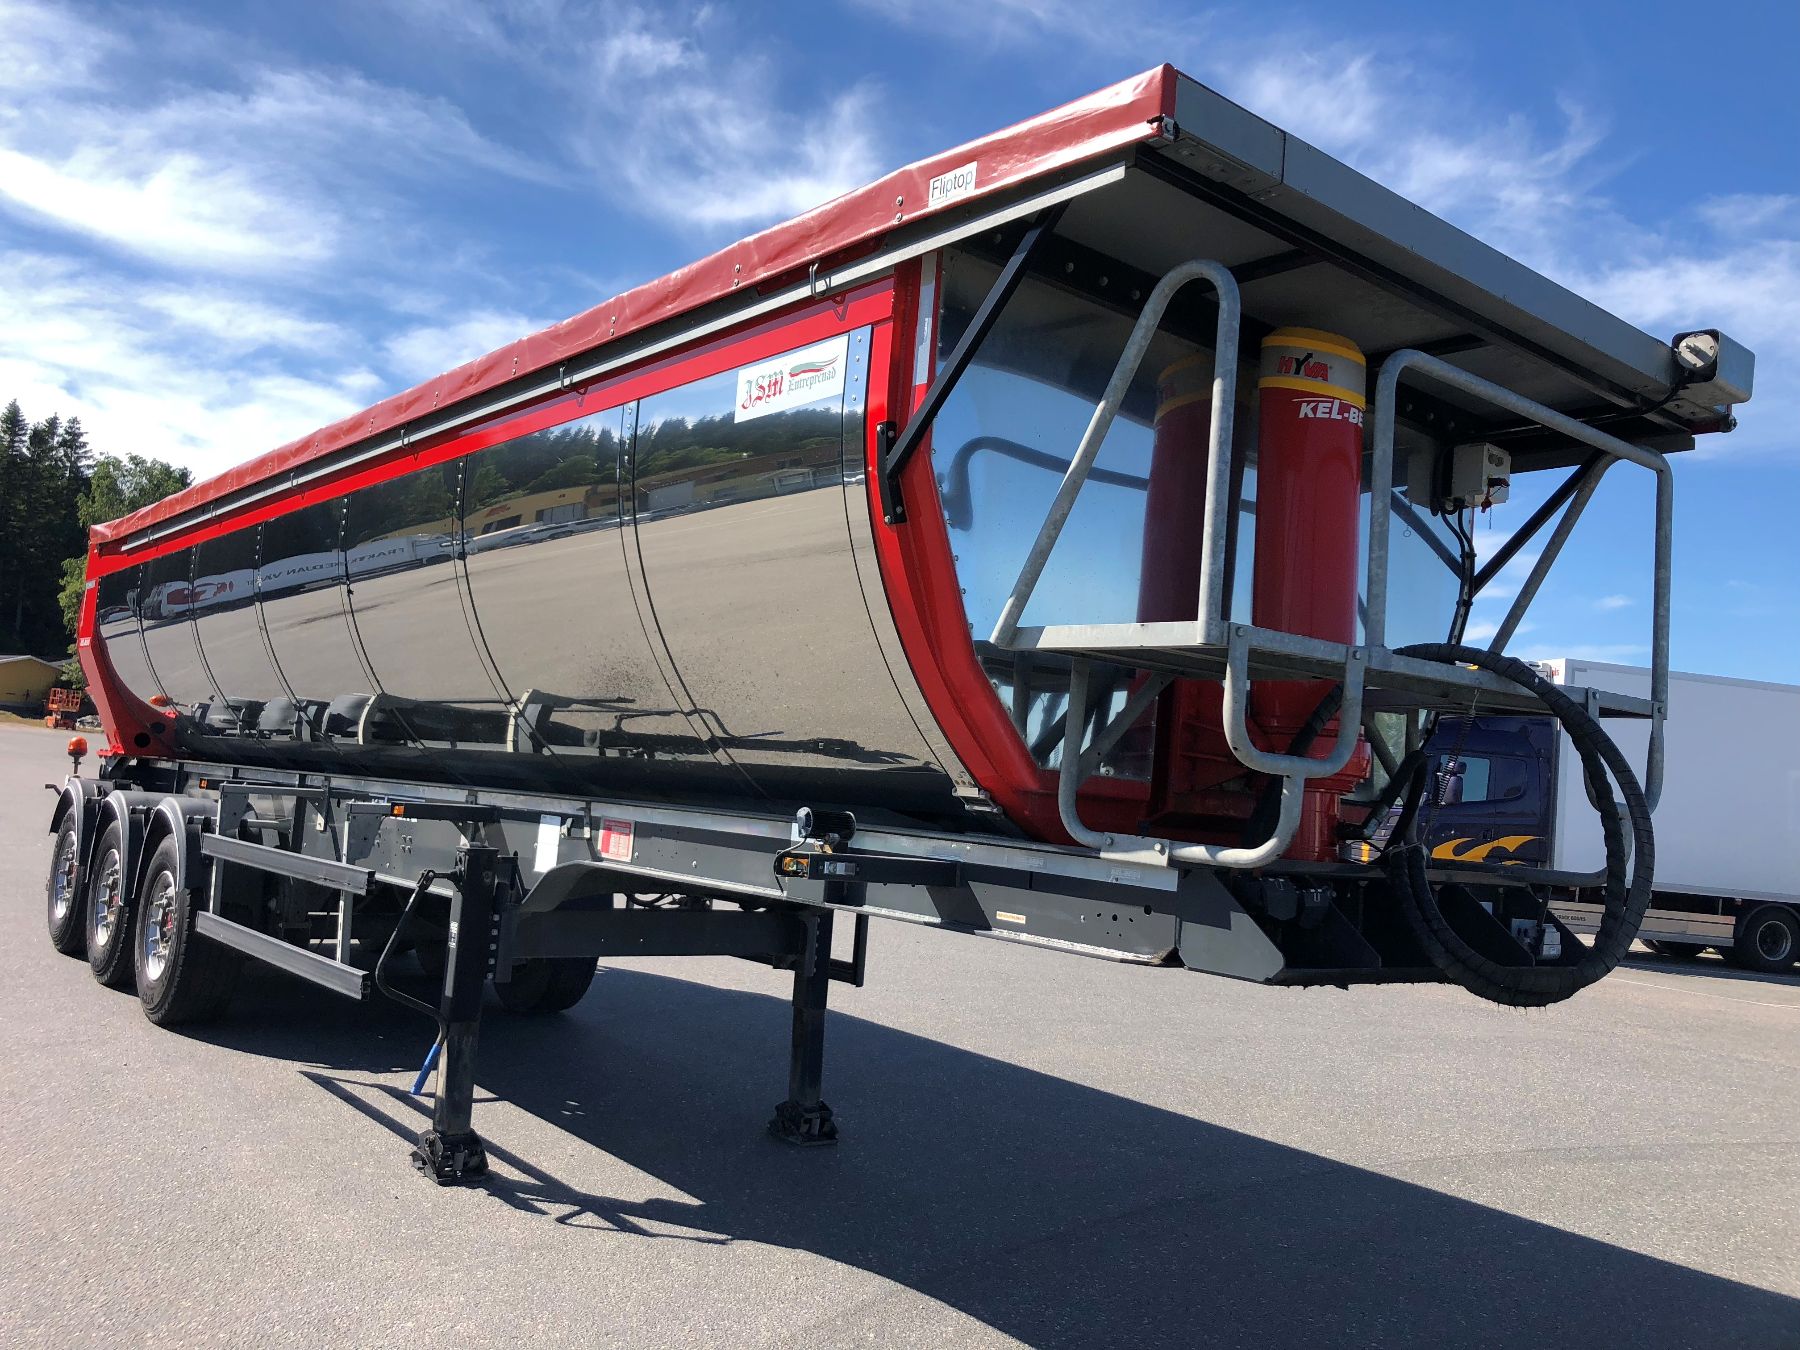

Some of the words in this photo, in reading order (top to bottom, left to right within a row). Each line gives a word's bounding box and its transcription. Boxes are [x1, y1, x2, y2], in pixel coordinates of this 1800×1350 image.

[931, 170, 973, 199] Fliptop
[786, 366, 837, 395] Entreprenad
[1277, 352, 1329, 382] HYVA
